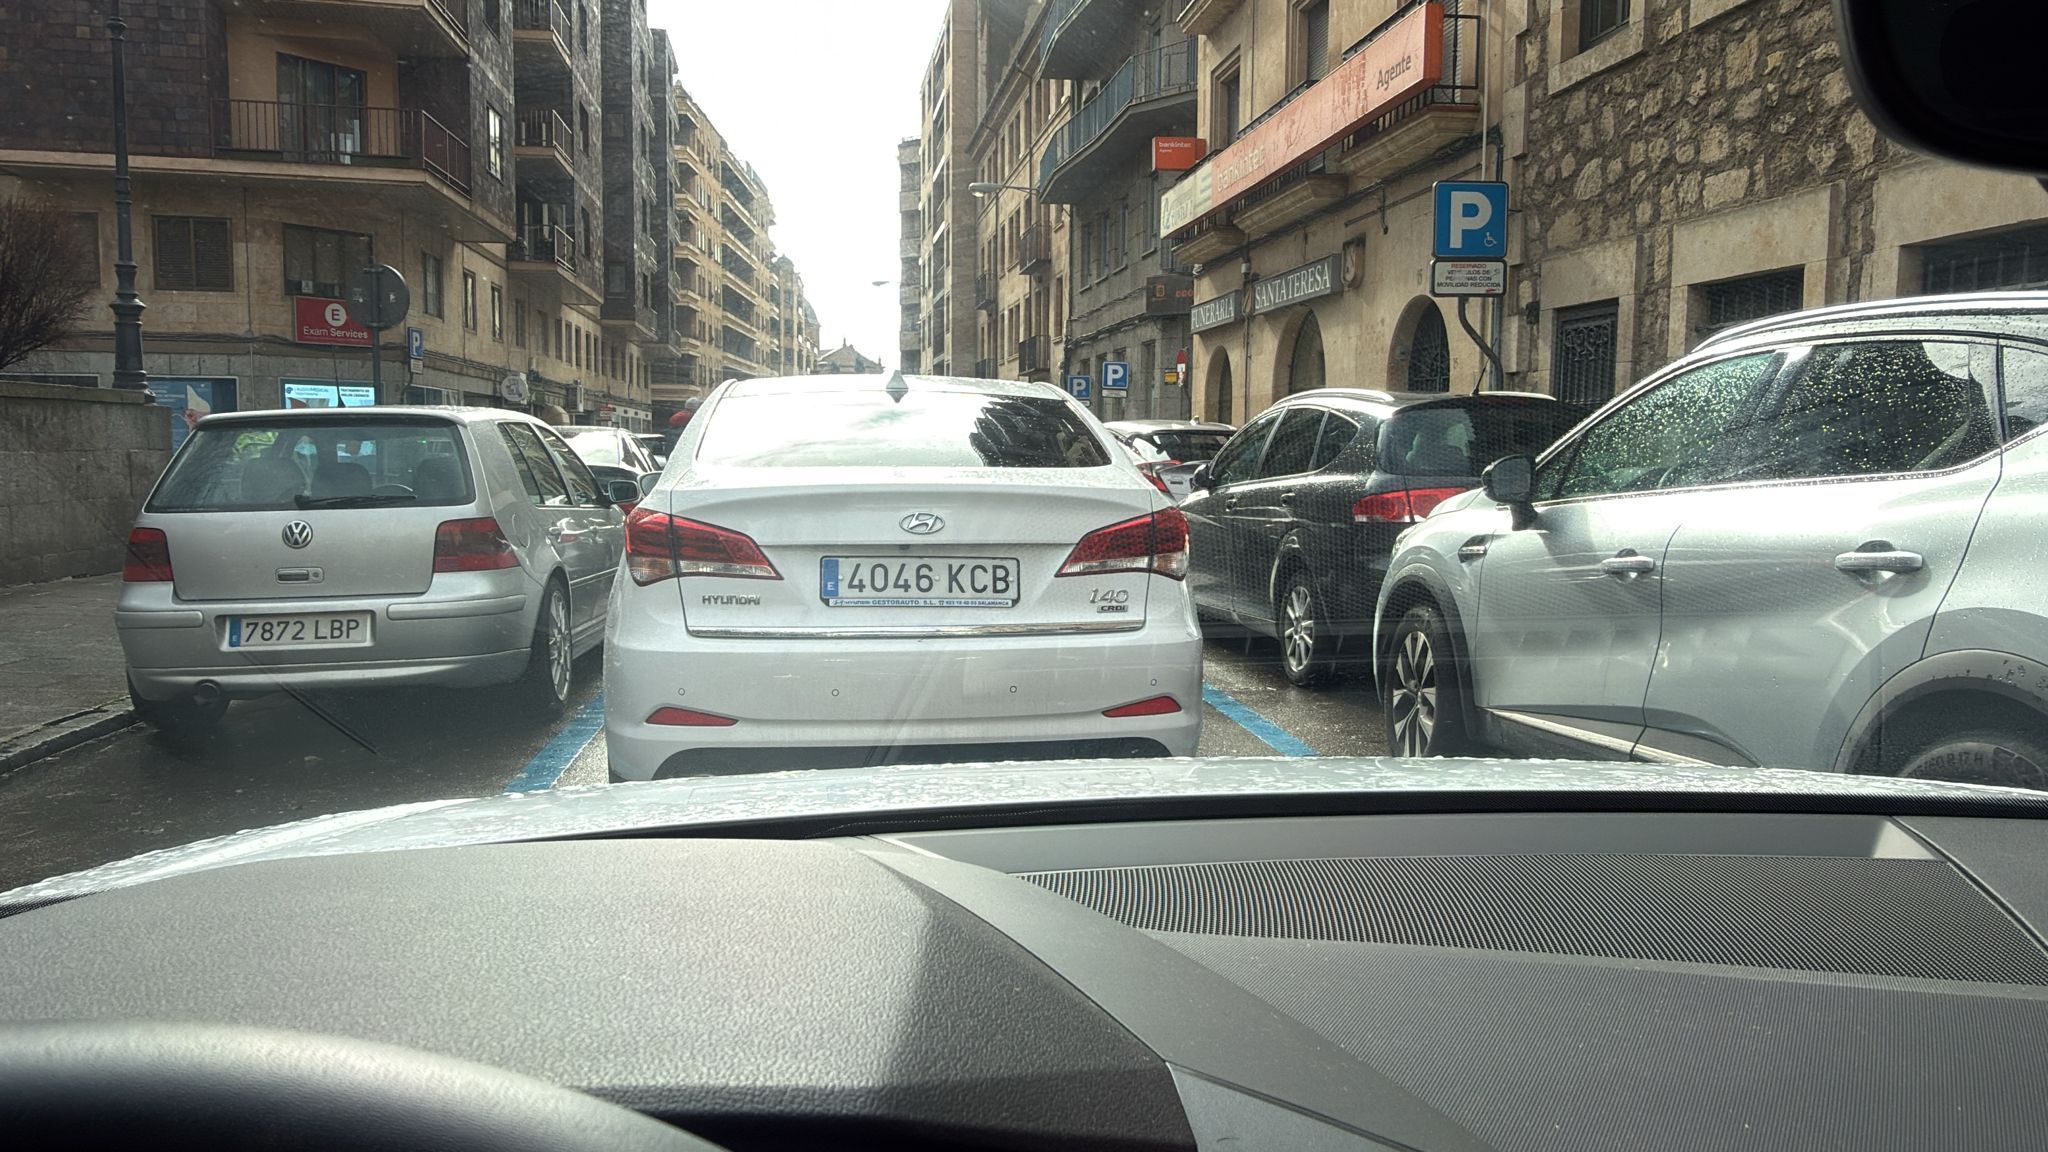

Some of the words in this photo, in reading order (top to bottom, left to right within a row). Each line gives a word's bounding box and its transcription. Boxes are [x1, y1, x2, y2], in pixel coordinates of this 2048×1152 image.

[1376, 54, 1412, 91] Agente
[1450, 191, 1492, 249] P
[331, 308, 340, 320] E
[1190, 297, 1235, 330] FUNERARIA
[303, 326, 329, 336] Exam
[330, 328, 369, 339] Services
[412, 331, 420, 356] P
[1106, 364, 1124, 386] P
[1073, 378, 1087, 397] P
[827, 582, 835, 591] E
[847, 563, 934, 593] 4046
[948, 563, 1010, 594] KCB
[702, 595, 761, 605] HYUNDAI
[245, 621, 305, 643] 7872
[314, 619, 360, 640] LBP
